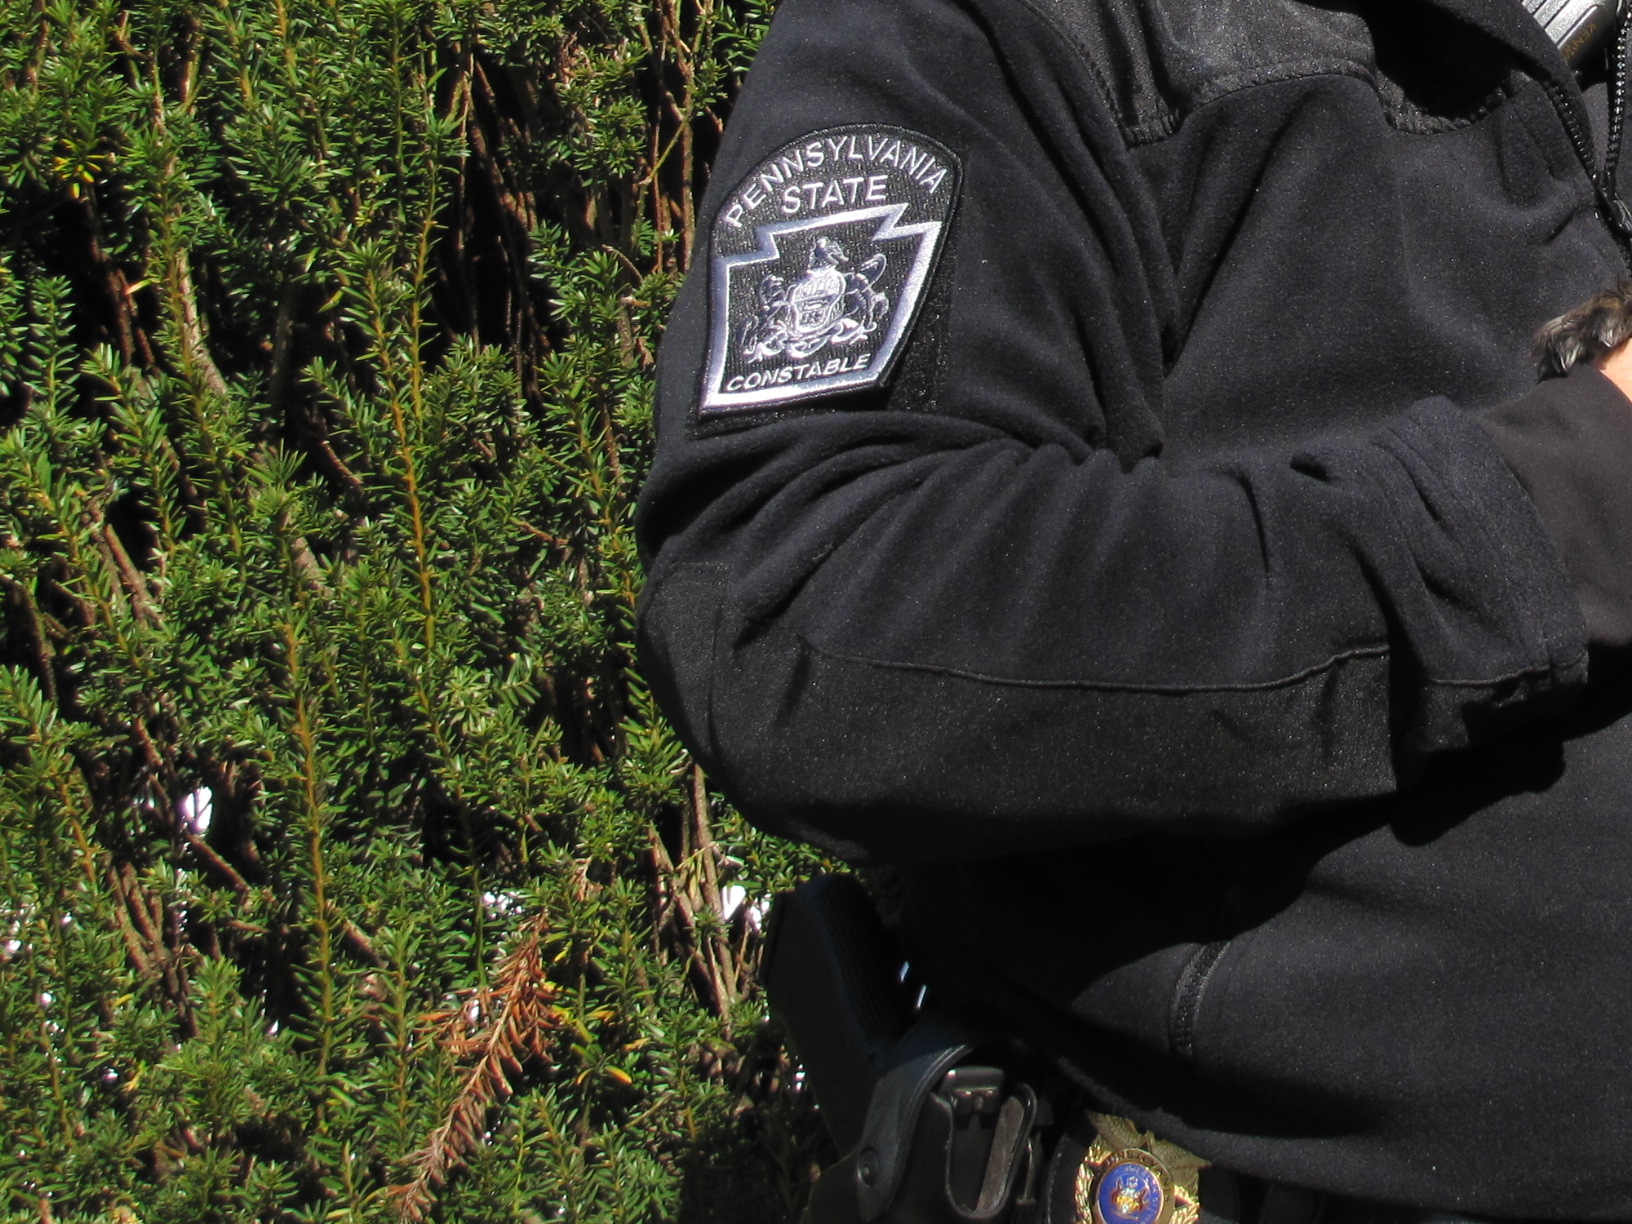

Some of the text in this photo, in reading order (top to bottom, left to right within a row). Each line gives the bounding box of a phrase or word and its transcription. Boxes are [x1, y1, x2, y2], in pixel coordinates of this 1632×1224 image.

[1562, 22, 1597, 58] KENW
[725, 135, 948, 228] PENNSYLVANIA
[783, 174, 889, 214] STATE
[726, 352, 871, 392] CONSTABLE
